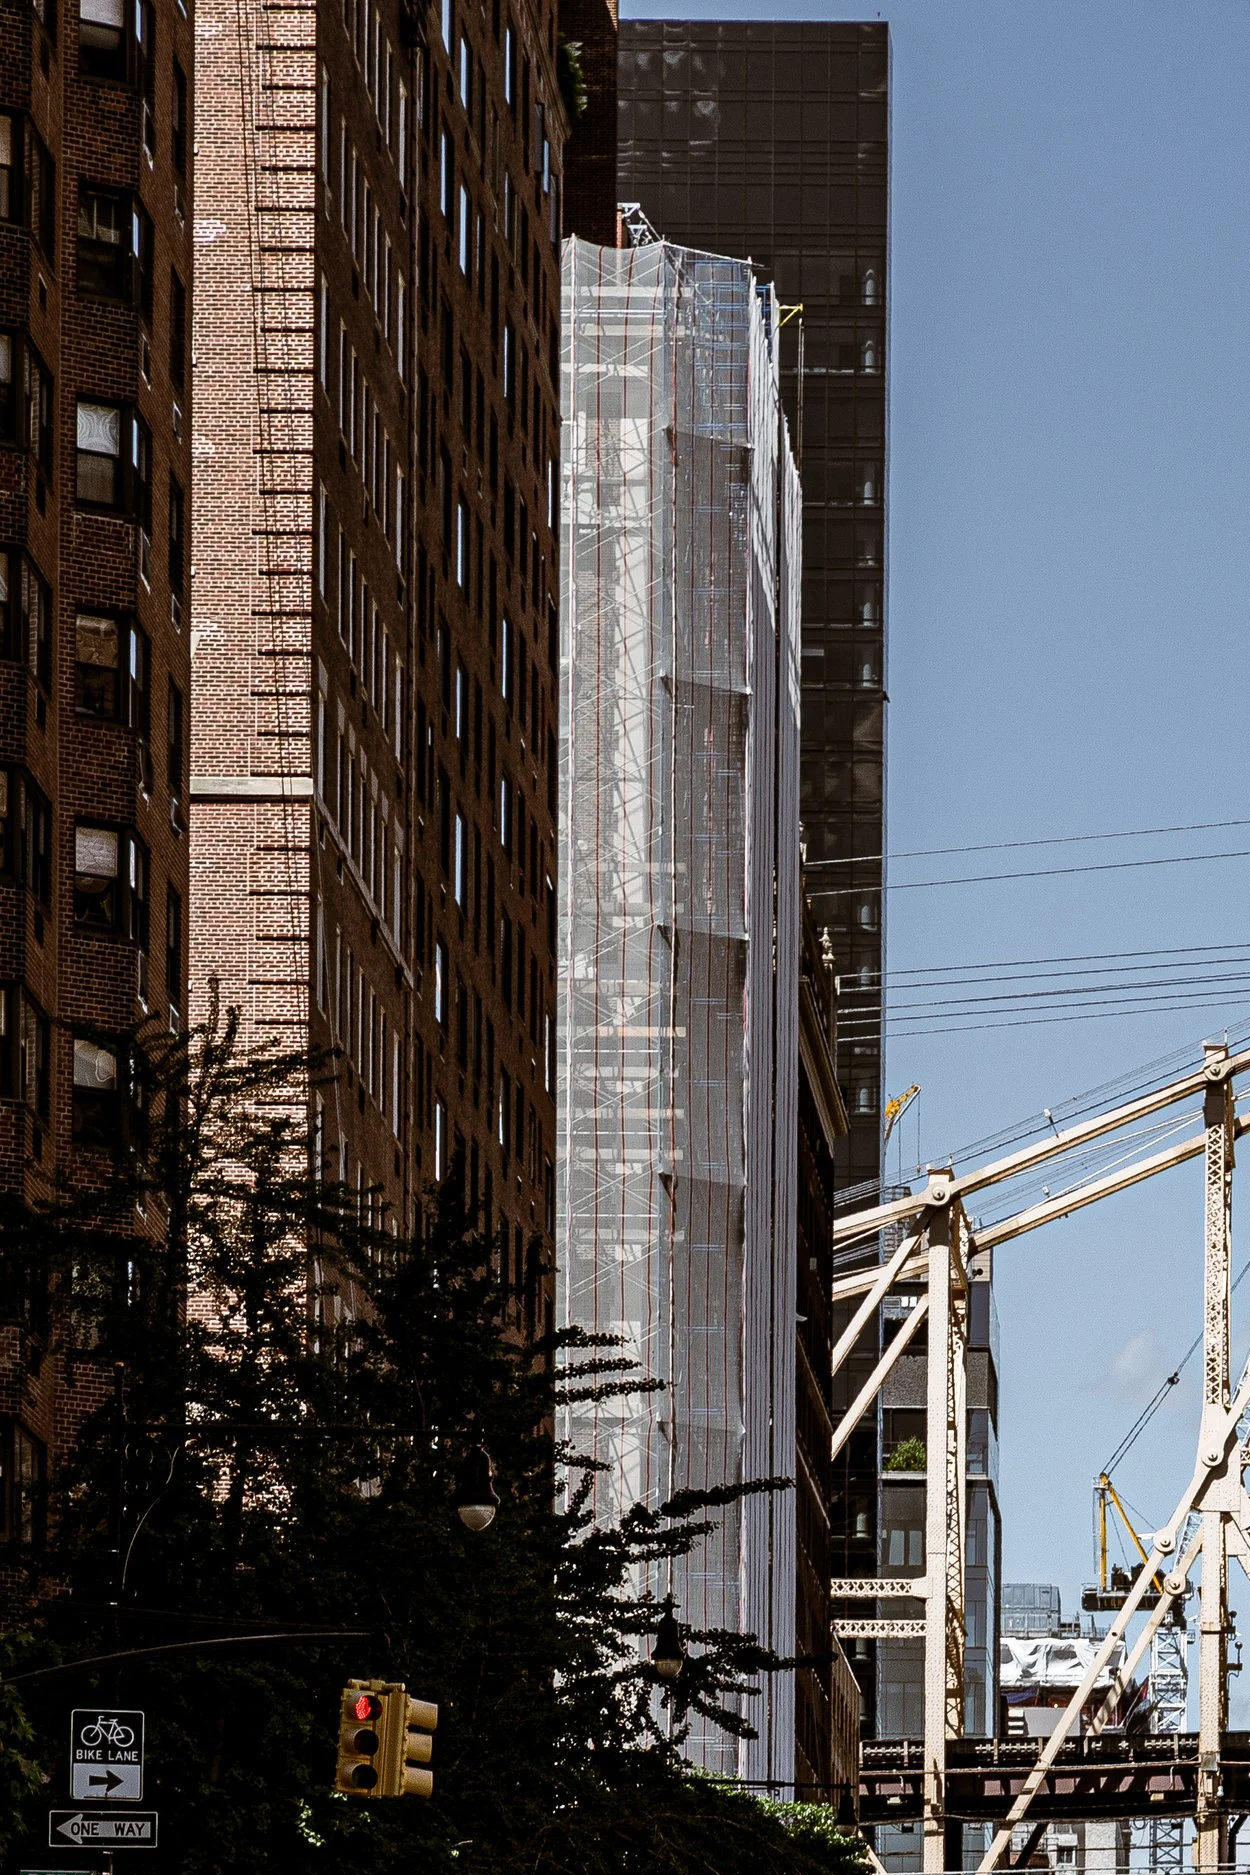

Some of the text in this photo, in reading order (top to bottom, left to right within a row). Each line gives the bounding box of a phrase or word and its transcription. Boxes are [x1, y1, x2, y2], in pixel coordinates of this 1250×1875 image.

[76, 1749, 139, 1762] BIKE LANE
[70, 1822, 146, 1837] ONE WAY
